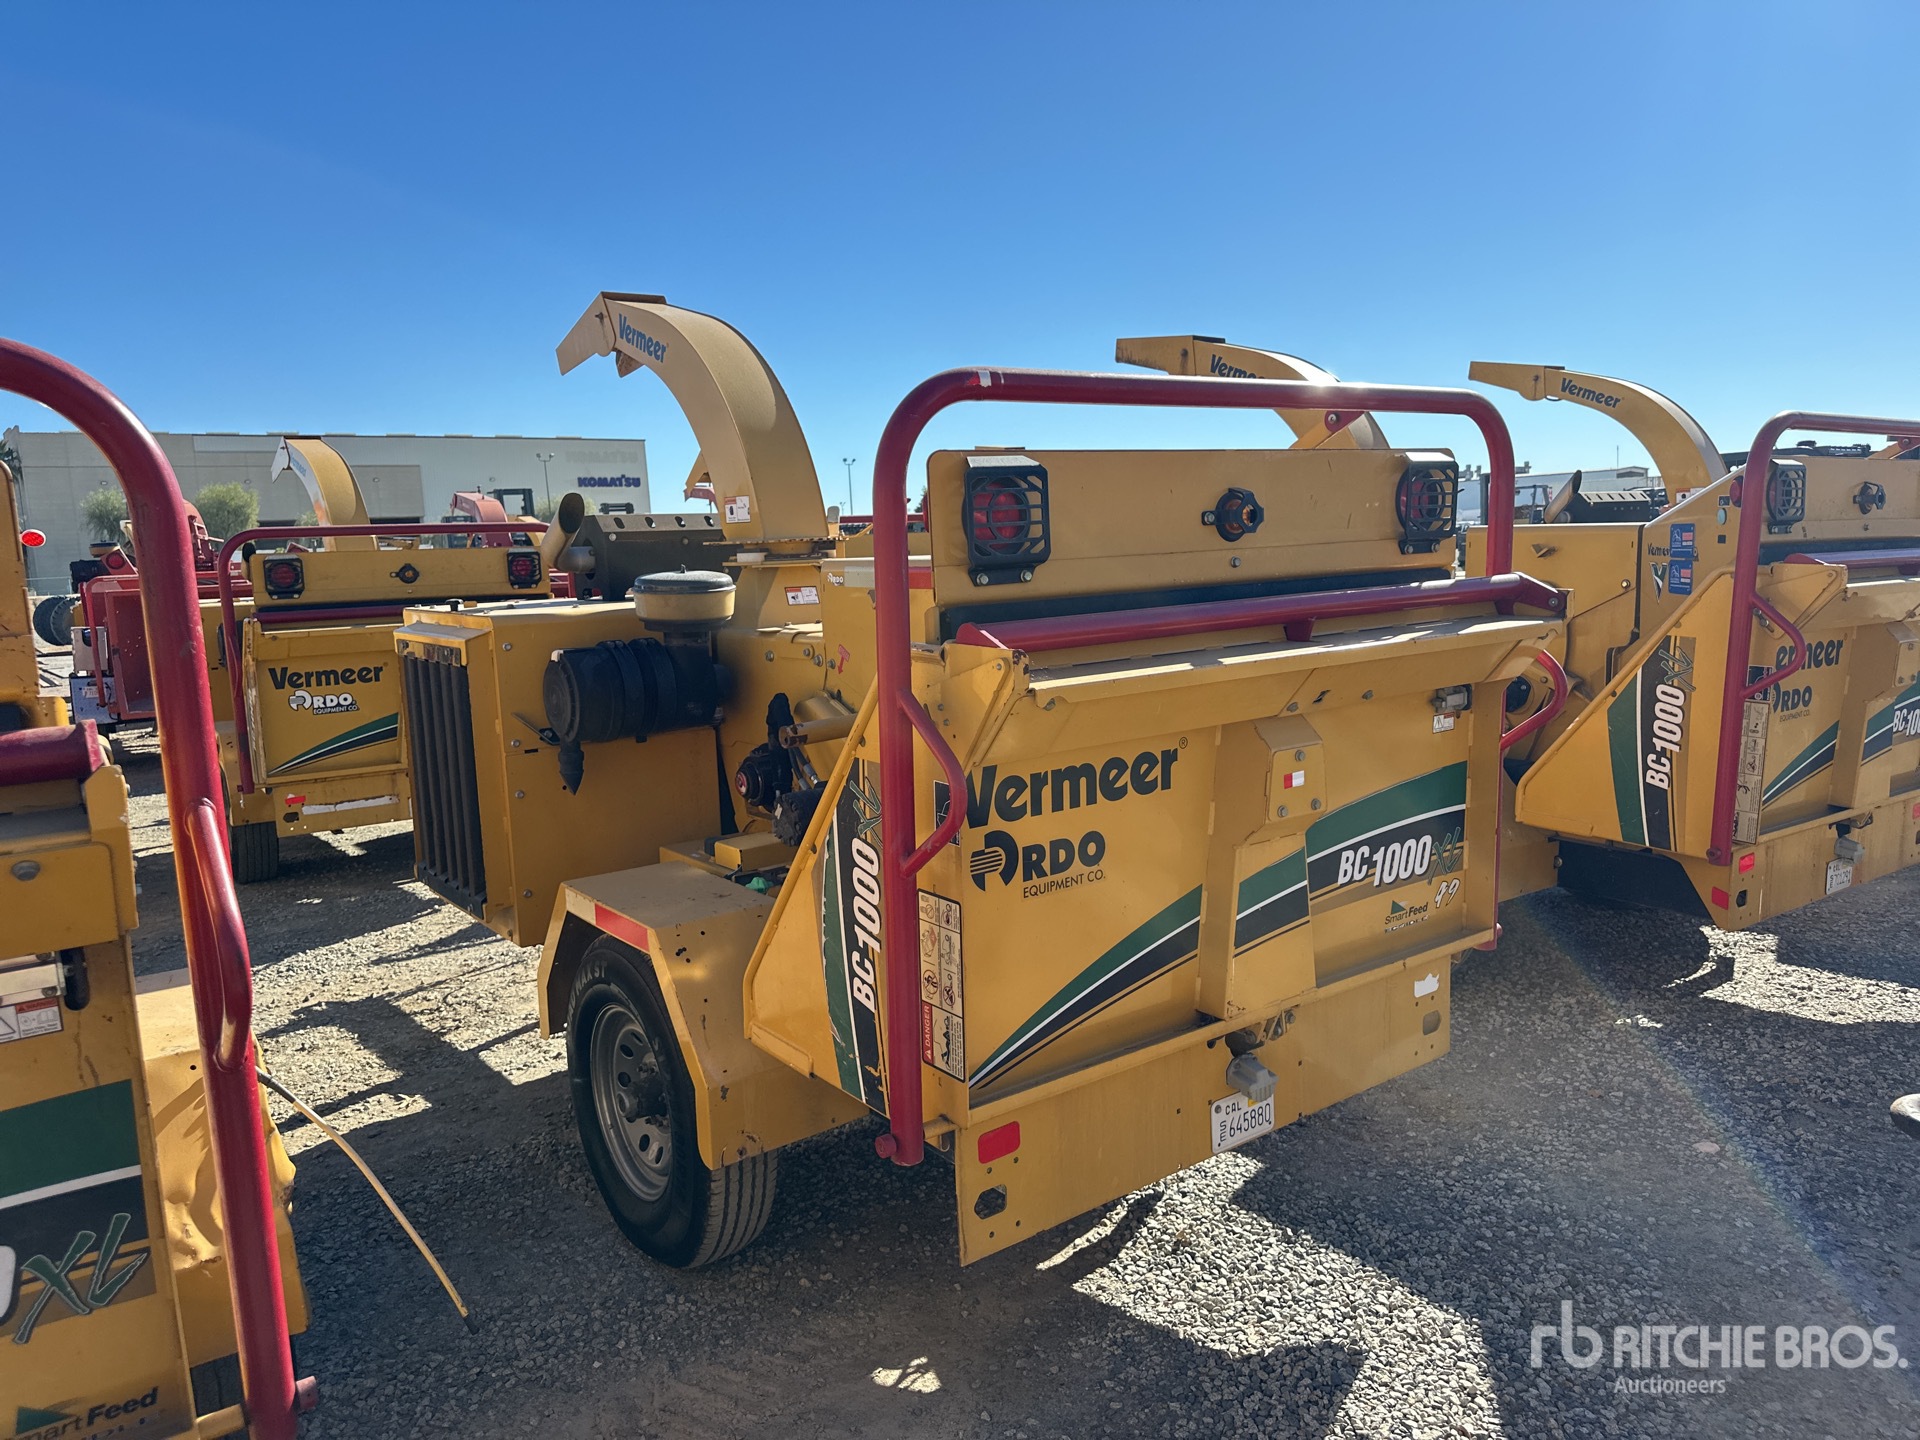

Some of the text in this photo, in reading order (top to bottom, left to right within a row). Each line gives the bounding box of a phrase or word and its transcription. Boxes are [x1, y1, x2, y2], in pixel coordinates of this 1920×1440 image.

[619, 313, 667, 363] Vermeer
[1560, 378, 1621, 408] Vermeer
[577, 474, 641, 487] KOMATSU
[268, 666, 384, 690] Vermeer
[966, 748, 1179, 829] Vermeer
[1023, 869, 1106, 899] EQUIPMENT CO.
[923, 1005, 934, 1048] DANGER
[1225, 1101, 1242, 1115] CAL
[1229, 1103, 1271, 1138] 645880
